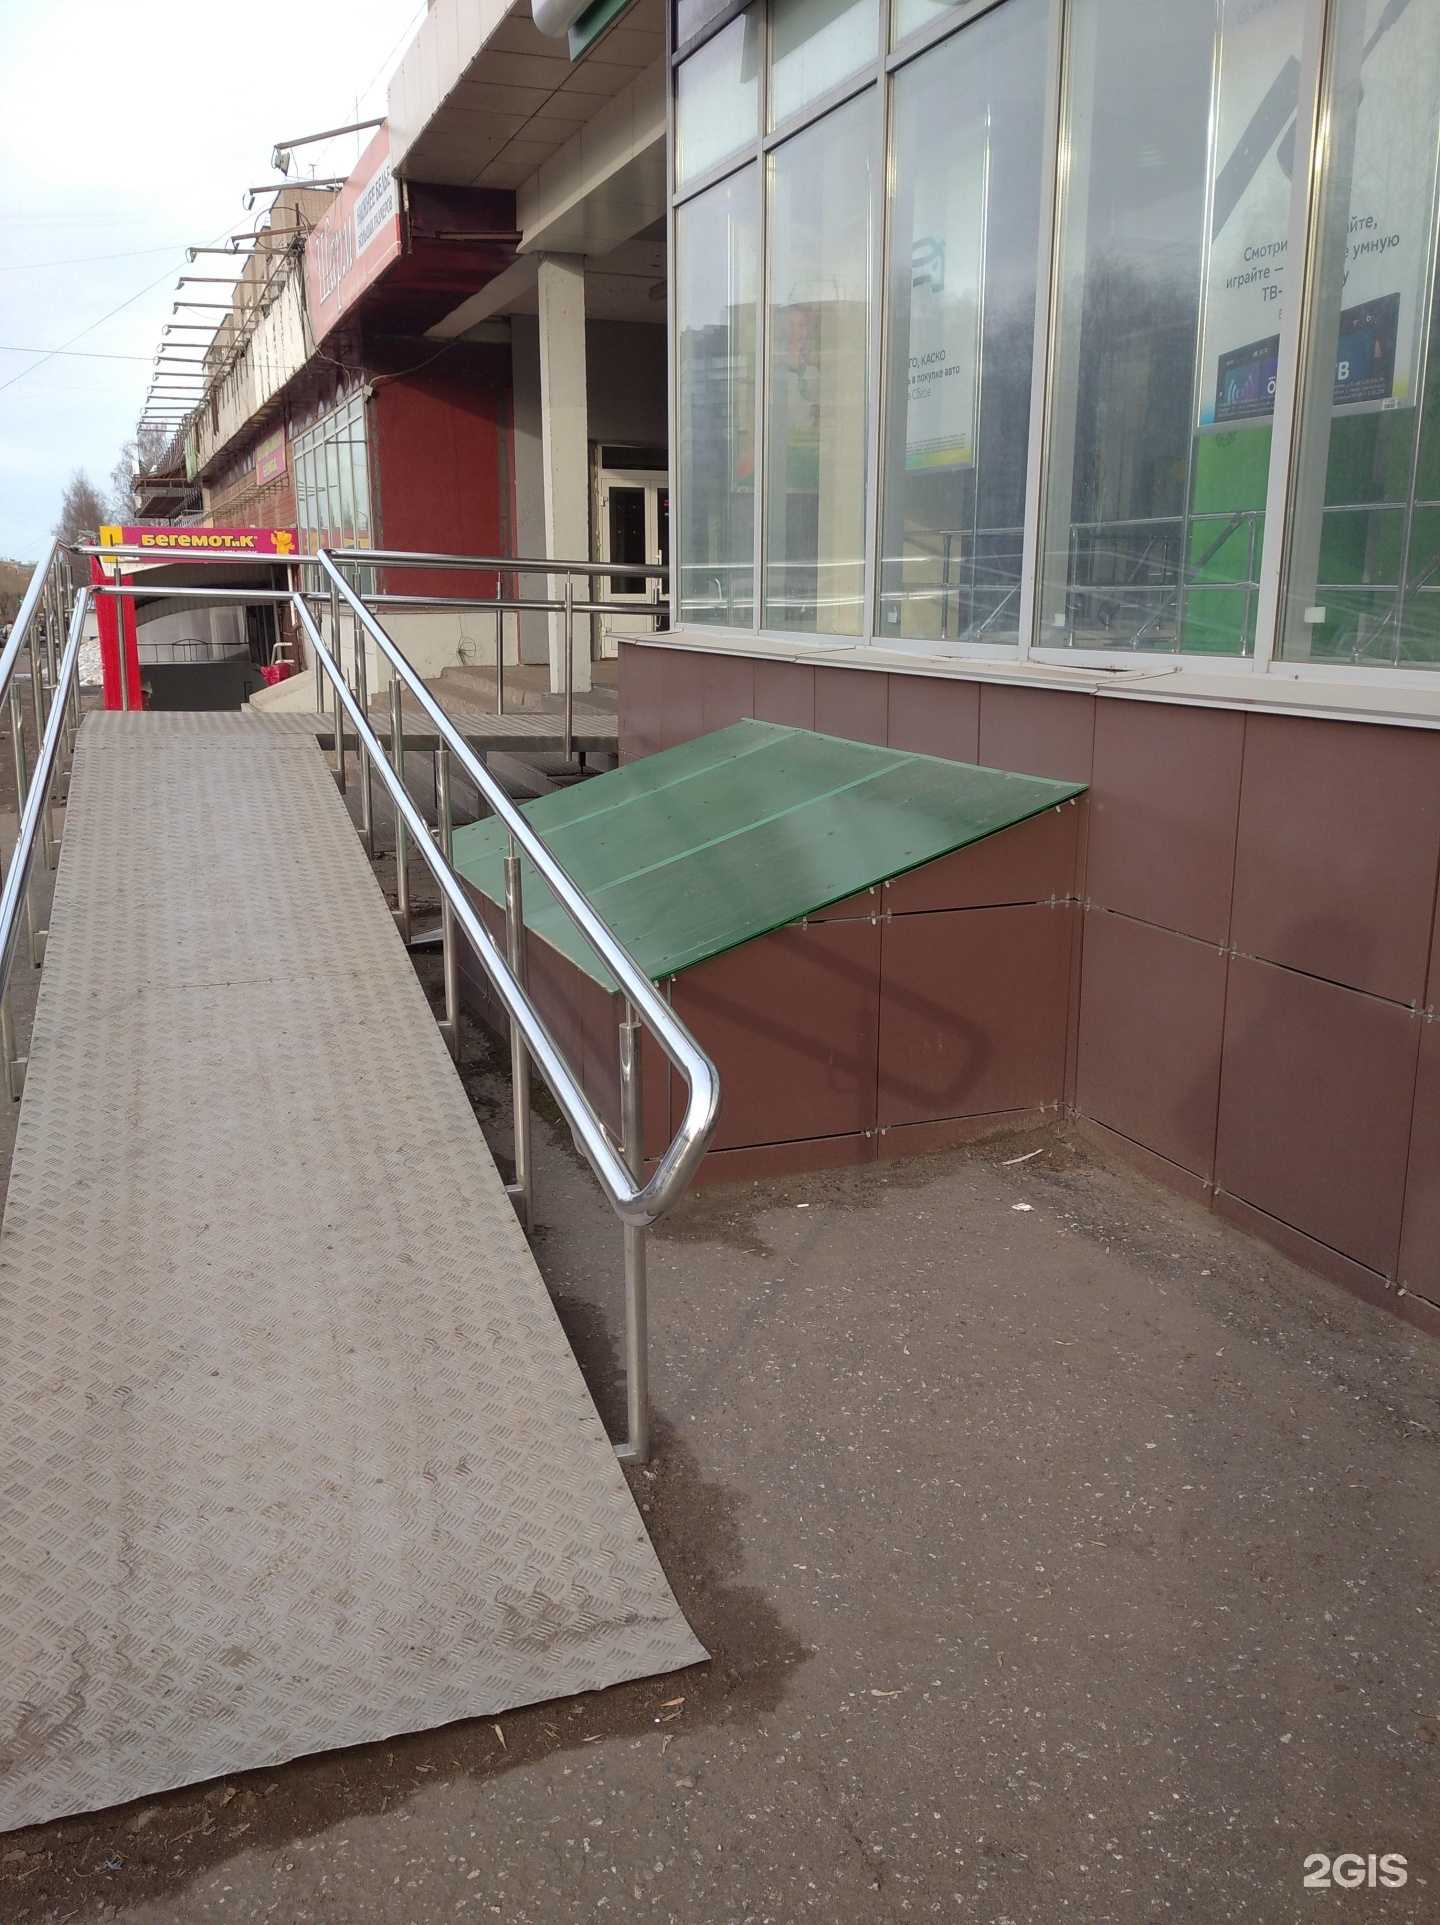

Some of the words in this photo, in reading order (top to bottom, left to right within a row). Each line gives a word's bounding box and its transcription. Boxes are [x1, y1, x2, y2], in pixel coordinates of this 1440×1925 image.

[1244, 240, 1288, 261] Смотри
[1226, 267, 1271, 289] играйте
[1353, 234, 1400, 260] умную
[921, 350, 946, 368] КАСКО
[944, 366, 961, 377] авто
